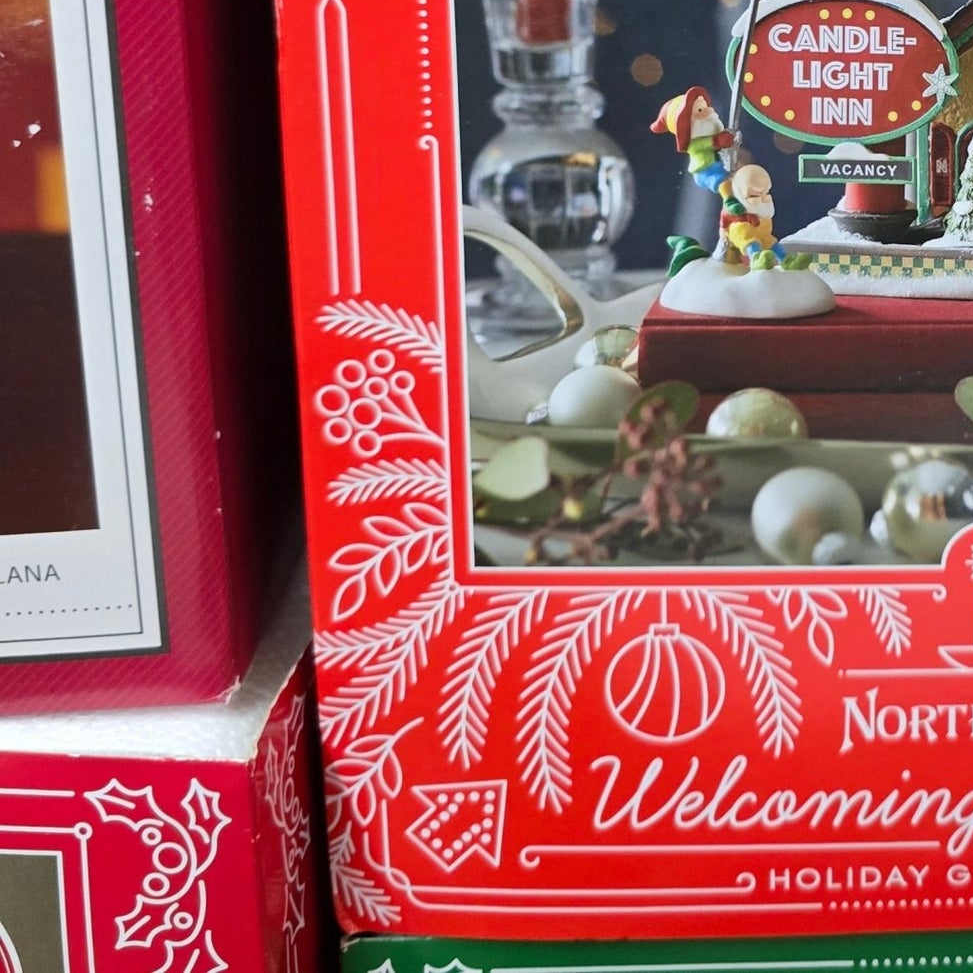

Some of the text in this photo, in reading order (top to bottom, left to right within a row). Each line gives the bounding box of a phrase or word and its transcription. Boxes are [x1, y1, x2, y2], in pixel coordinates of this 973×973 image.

[768, 24, 917, 55] CANDLE-
[793, 60, 893, 91] LIGHT
[811, 97, 873, 126] INN
[820, 163, 898, 177] VACANCY
[769, 865, 930, 891] HOLIDAY
